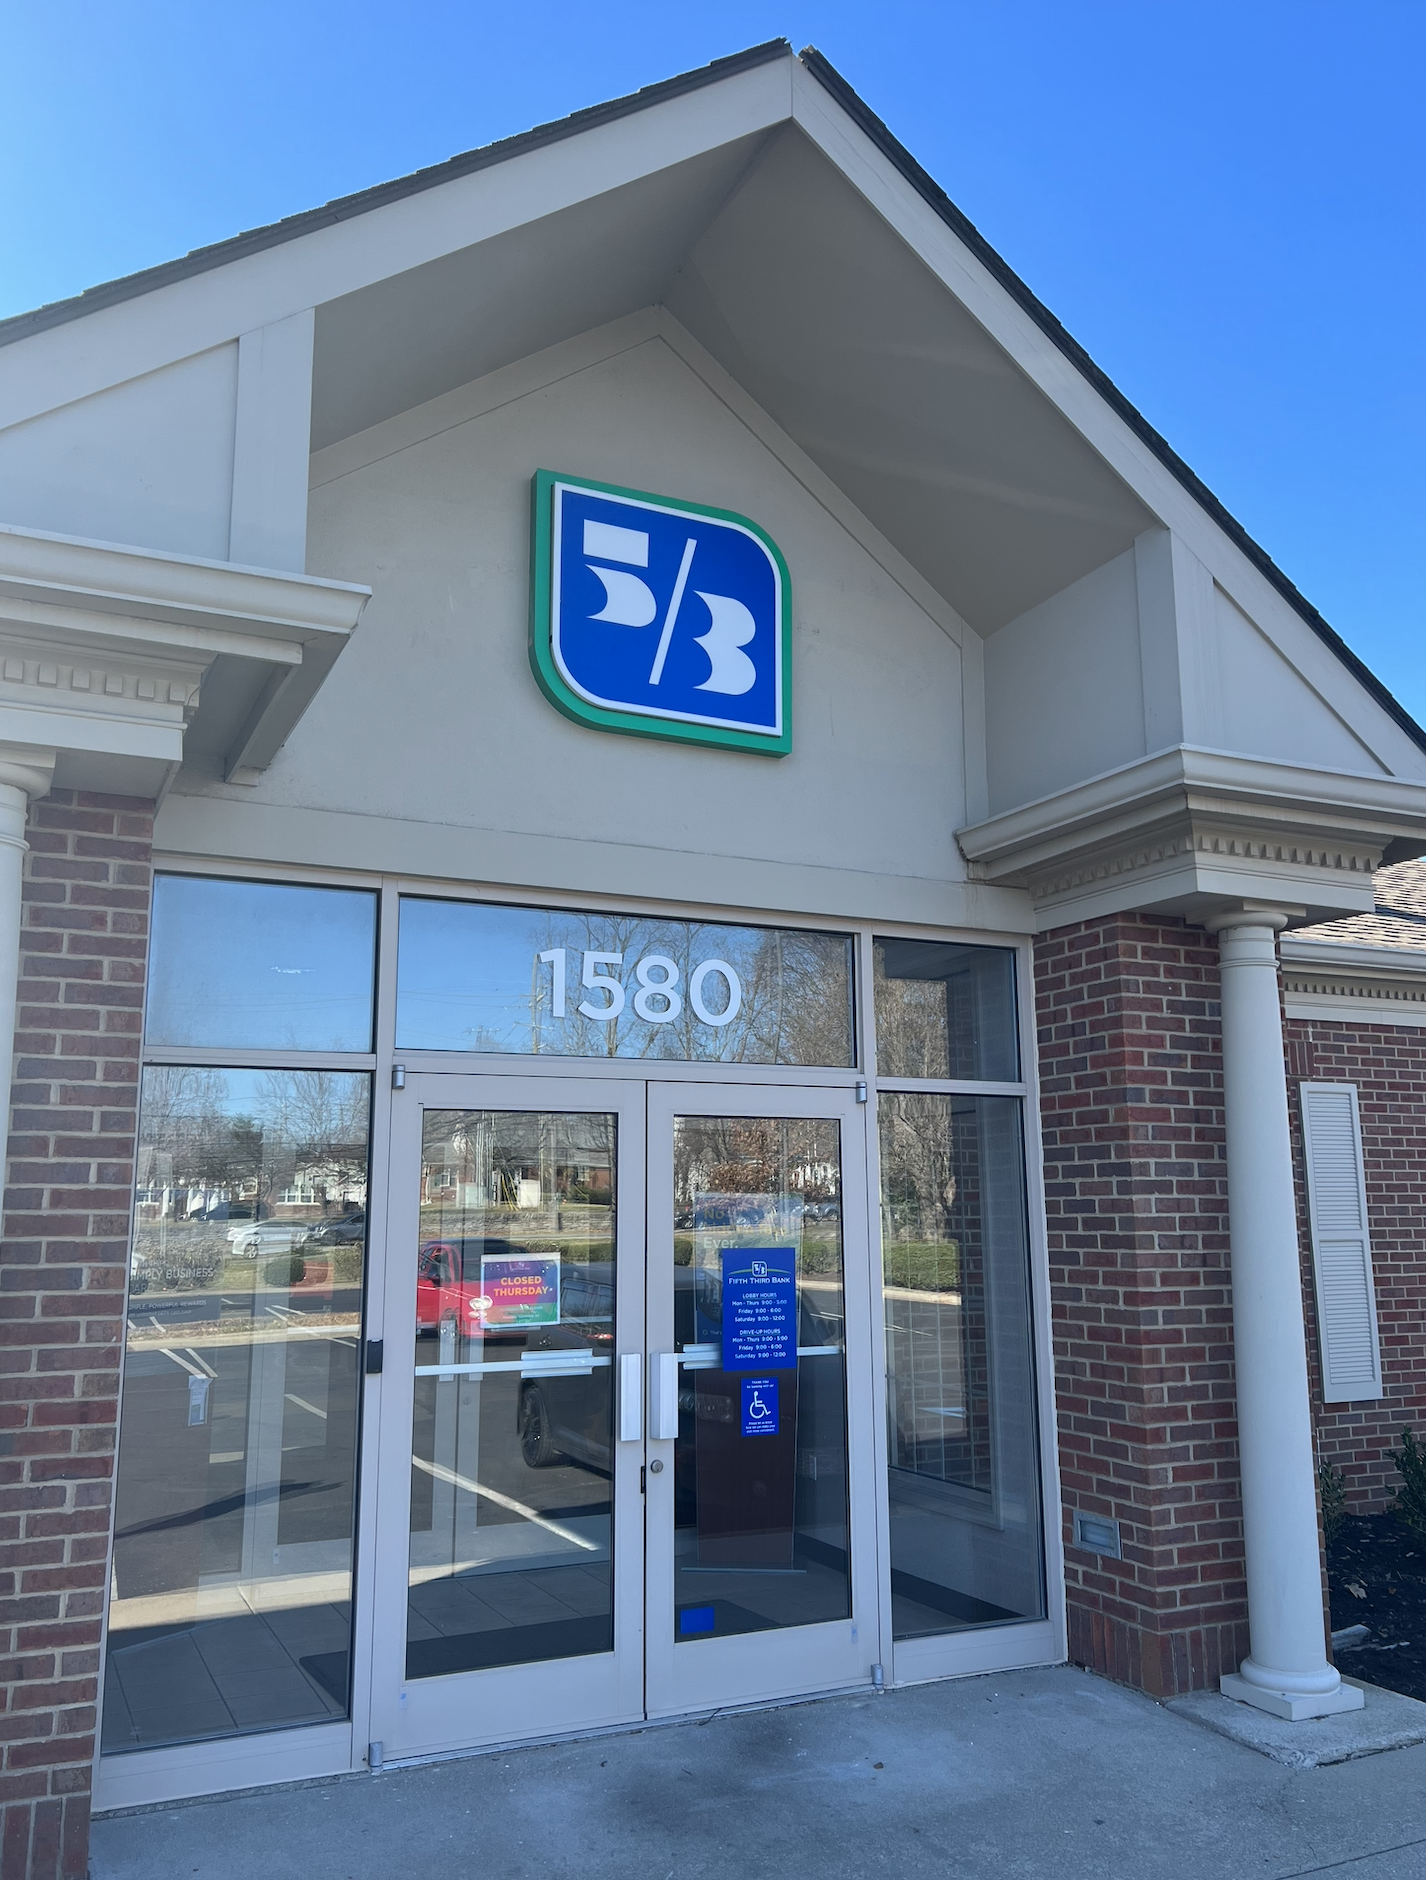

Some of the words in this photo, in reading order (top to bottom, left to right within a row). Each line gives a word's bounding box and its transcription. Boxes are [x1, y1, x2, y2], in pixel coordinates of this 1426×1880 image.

[539, 948, 741, 1027] 1580
[703, 1236, 739, 1249] Ever.
[165, 1267, 214, 1279] BUSINESS
[500, 1275, 542, 1286] CLOSED
[728, 1277, 748, 1285] FIFTH
[771, 1276, 791, 1284] BANK
[493, 1286, 549, 1297] THURSDAY
[180, 1299, 207, 1307] REWARDS
[739, 1328, 763, 1336] DRIVE-UP
